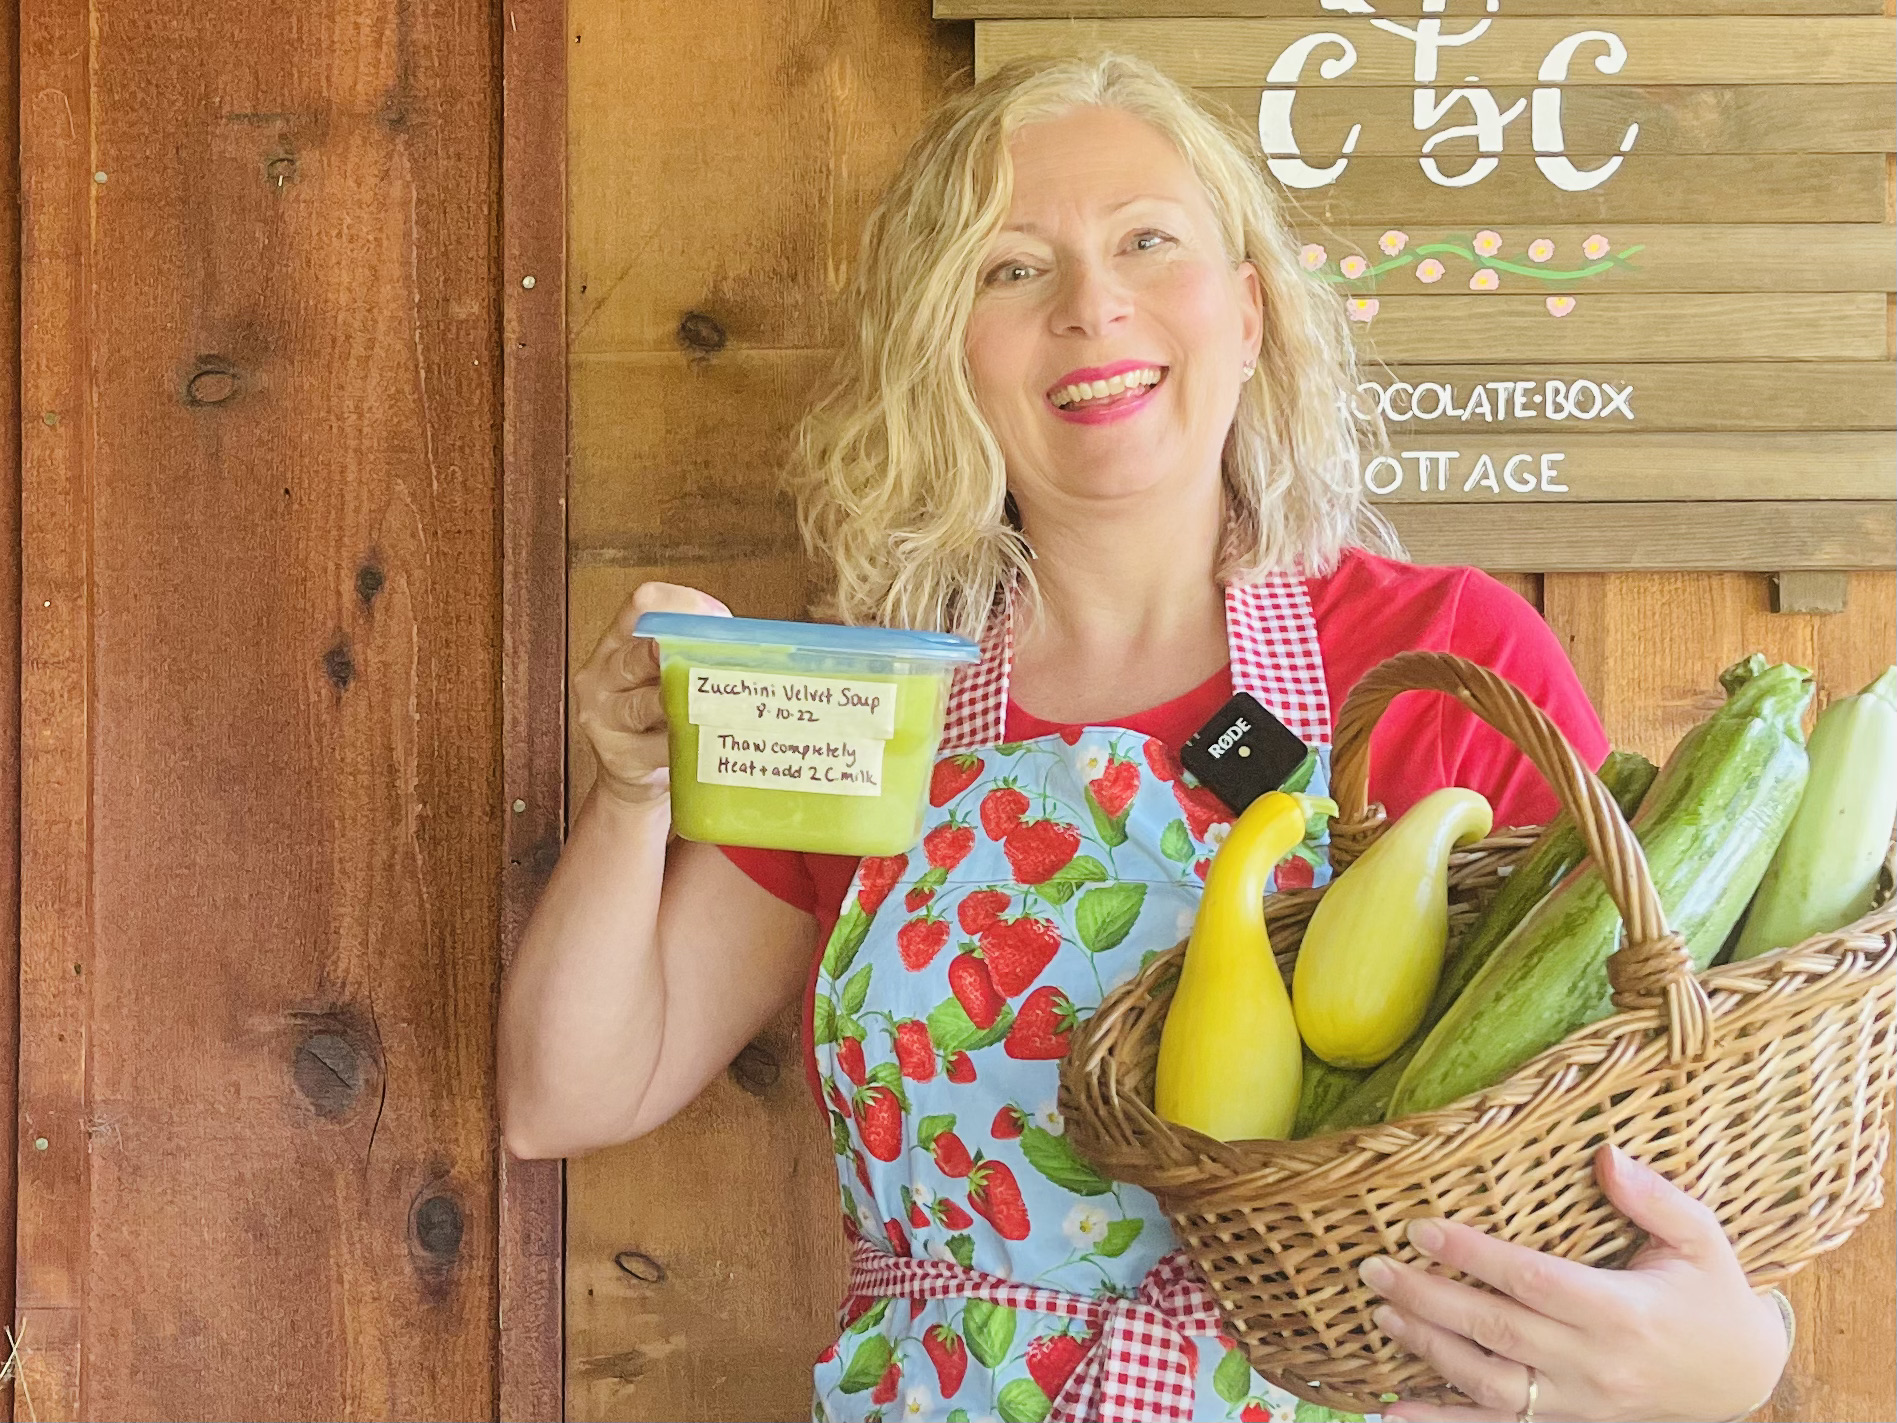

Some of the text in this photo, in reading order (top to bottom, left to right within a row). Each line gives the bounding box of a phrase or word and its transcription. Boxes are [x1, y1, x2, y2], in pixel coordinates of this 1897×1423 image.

[697, 676, 880, 714] Zucchini Velvet Soup
[717, 734, 857, 768] Thaw completely
[717, 756, 756, 776] Heat
[771, 764, 802, 779] add
[808, 766, 821, 781] 2
[840, 769, 877, 786] milk
